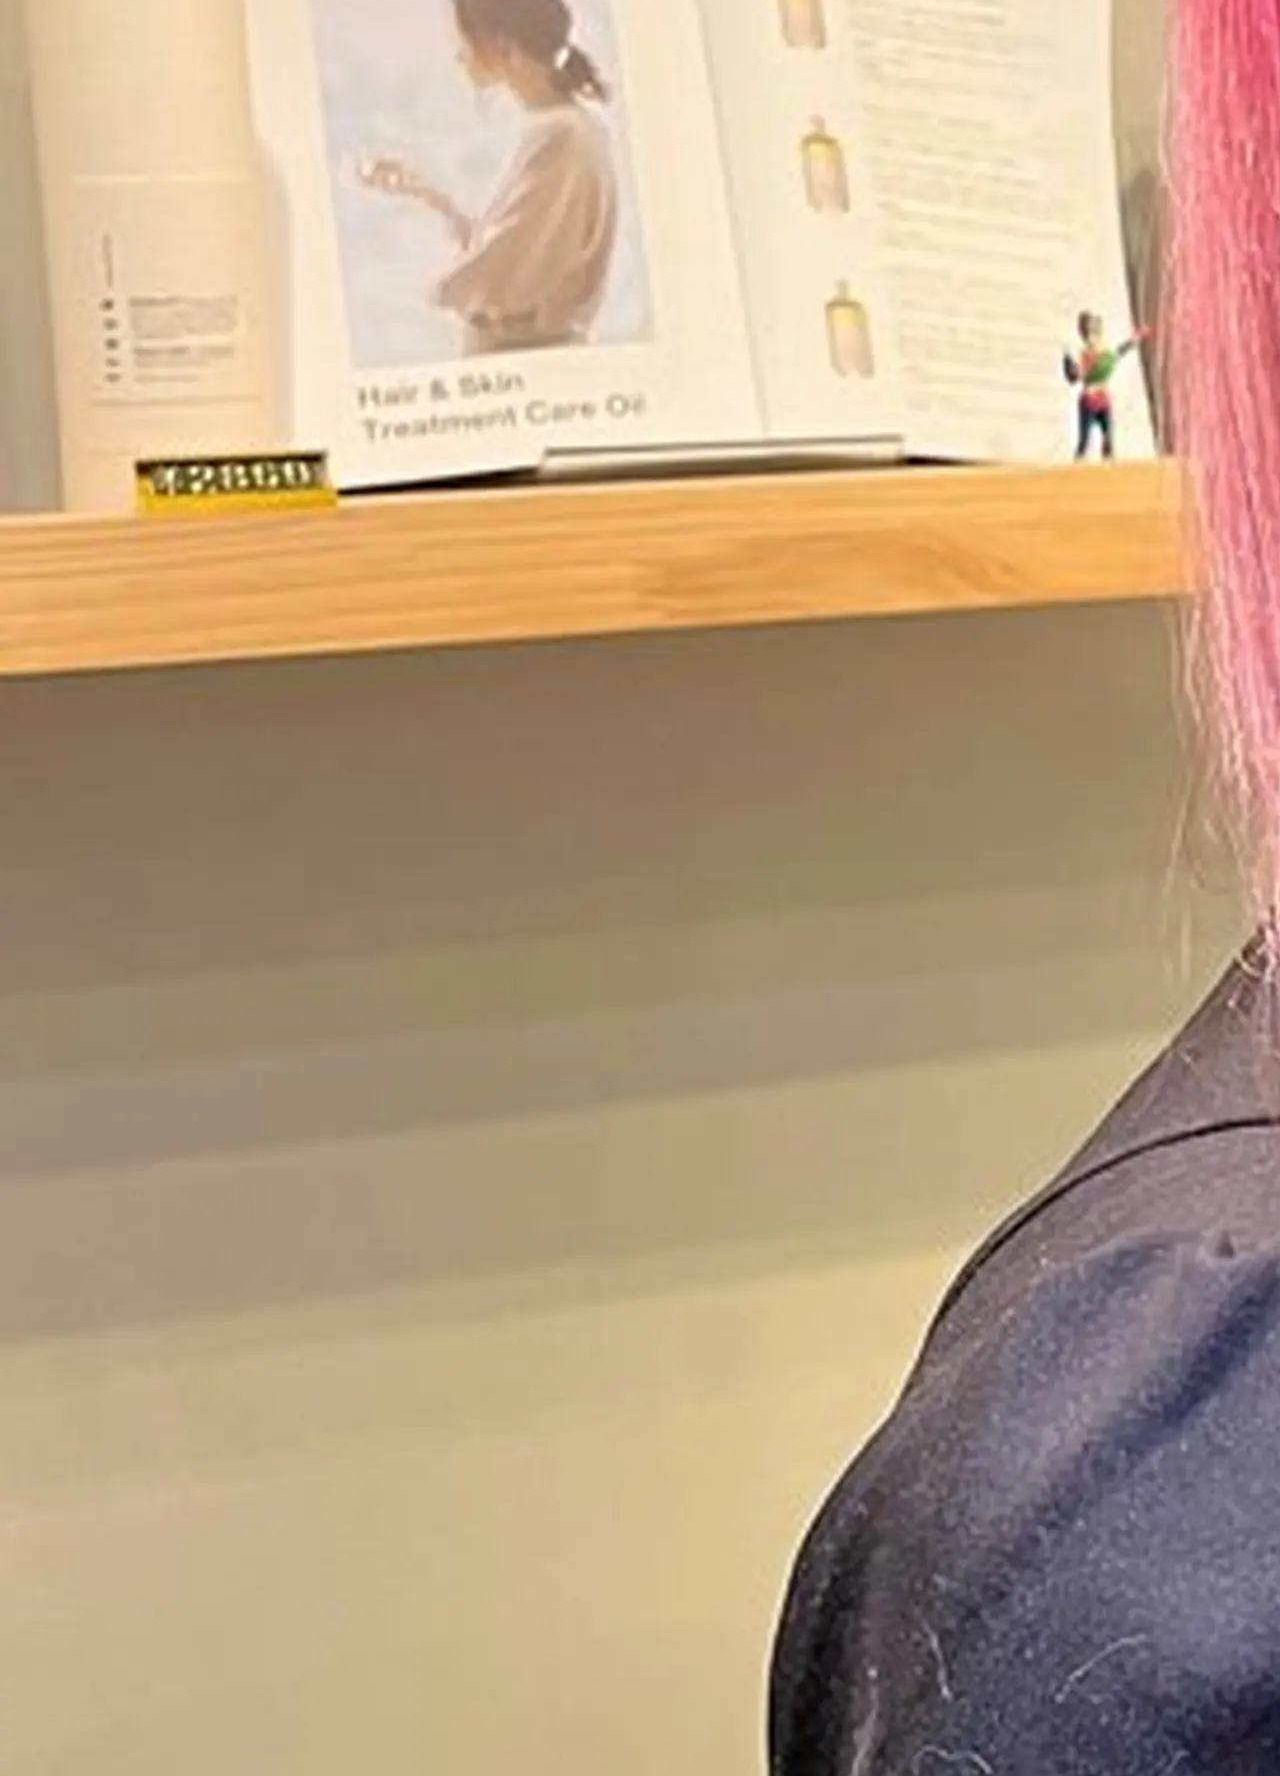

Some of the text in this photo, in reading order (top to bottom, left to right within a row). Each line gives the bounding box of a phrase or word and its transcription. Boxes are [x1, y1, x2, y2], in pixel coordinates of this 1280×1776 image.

[358, 371, 525, 410] Hair & Skin
[363, 391, 646, 443] Treatment Care Oil
